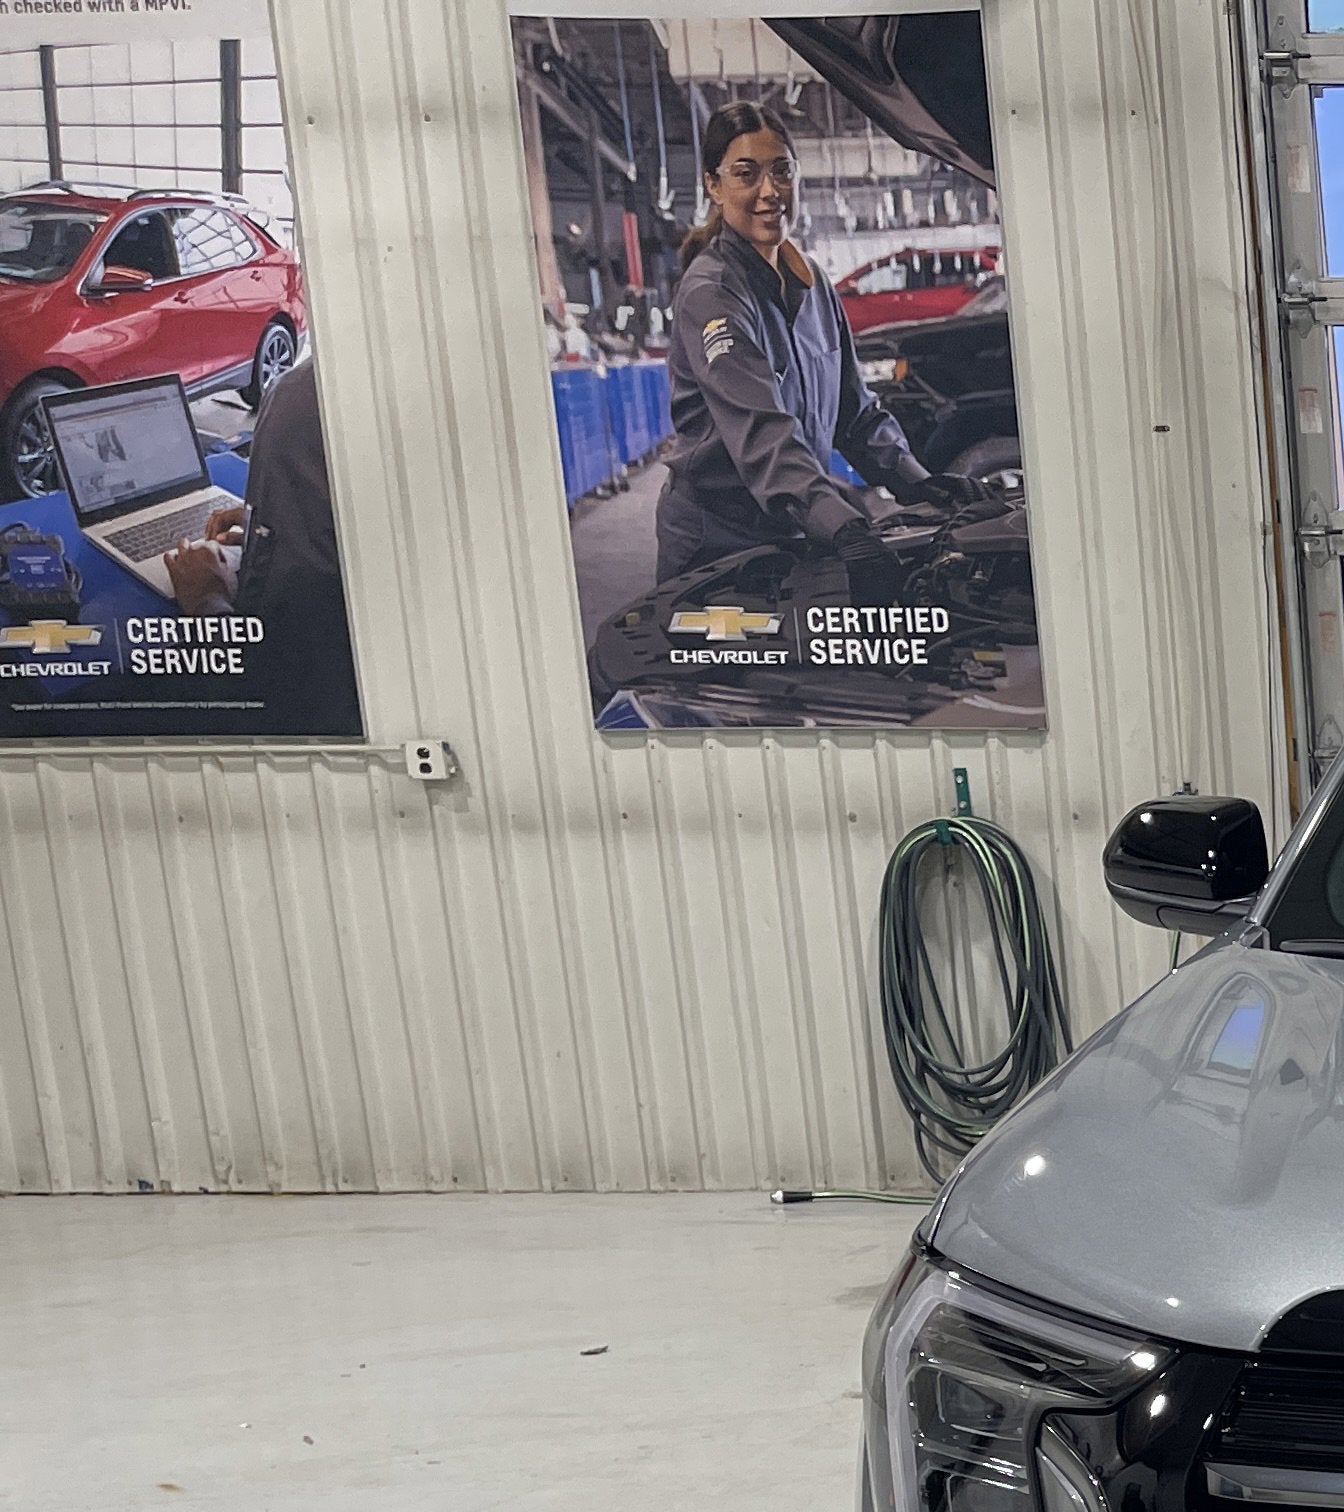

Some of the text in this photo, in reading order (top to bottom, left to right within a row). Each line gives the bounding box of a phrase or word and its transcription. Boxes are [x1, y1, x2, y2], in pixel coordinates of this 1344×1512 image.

[13, 0, 83, 14] checked
[87, 0, 125, 12] with
[130, 0, 139, 11] a
[126, 616, 265, 644] CERTIFIED
[806, 606, 950, 634] CERTIFIED
[130, 648, 245, 675] SERVICE
[669, 650, 789, 665] CHEVROLET
[809, 638, 928, 665] SERVICE
[0, 661, 112, 678] CHEVROLET
